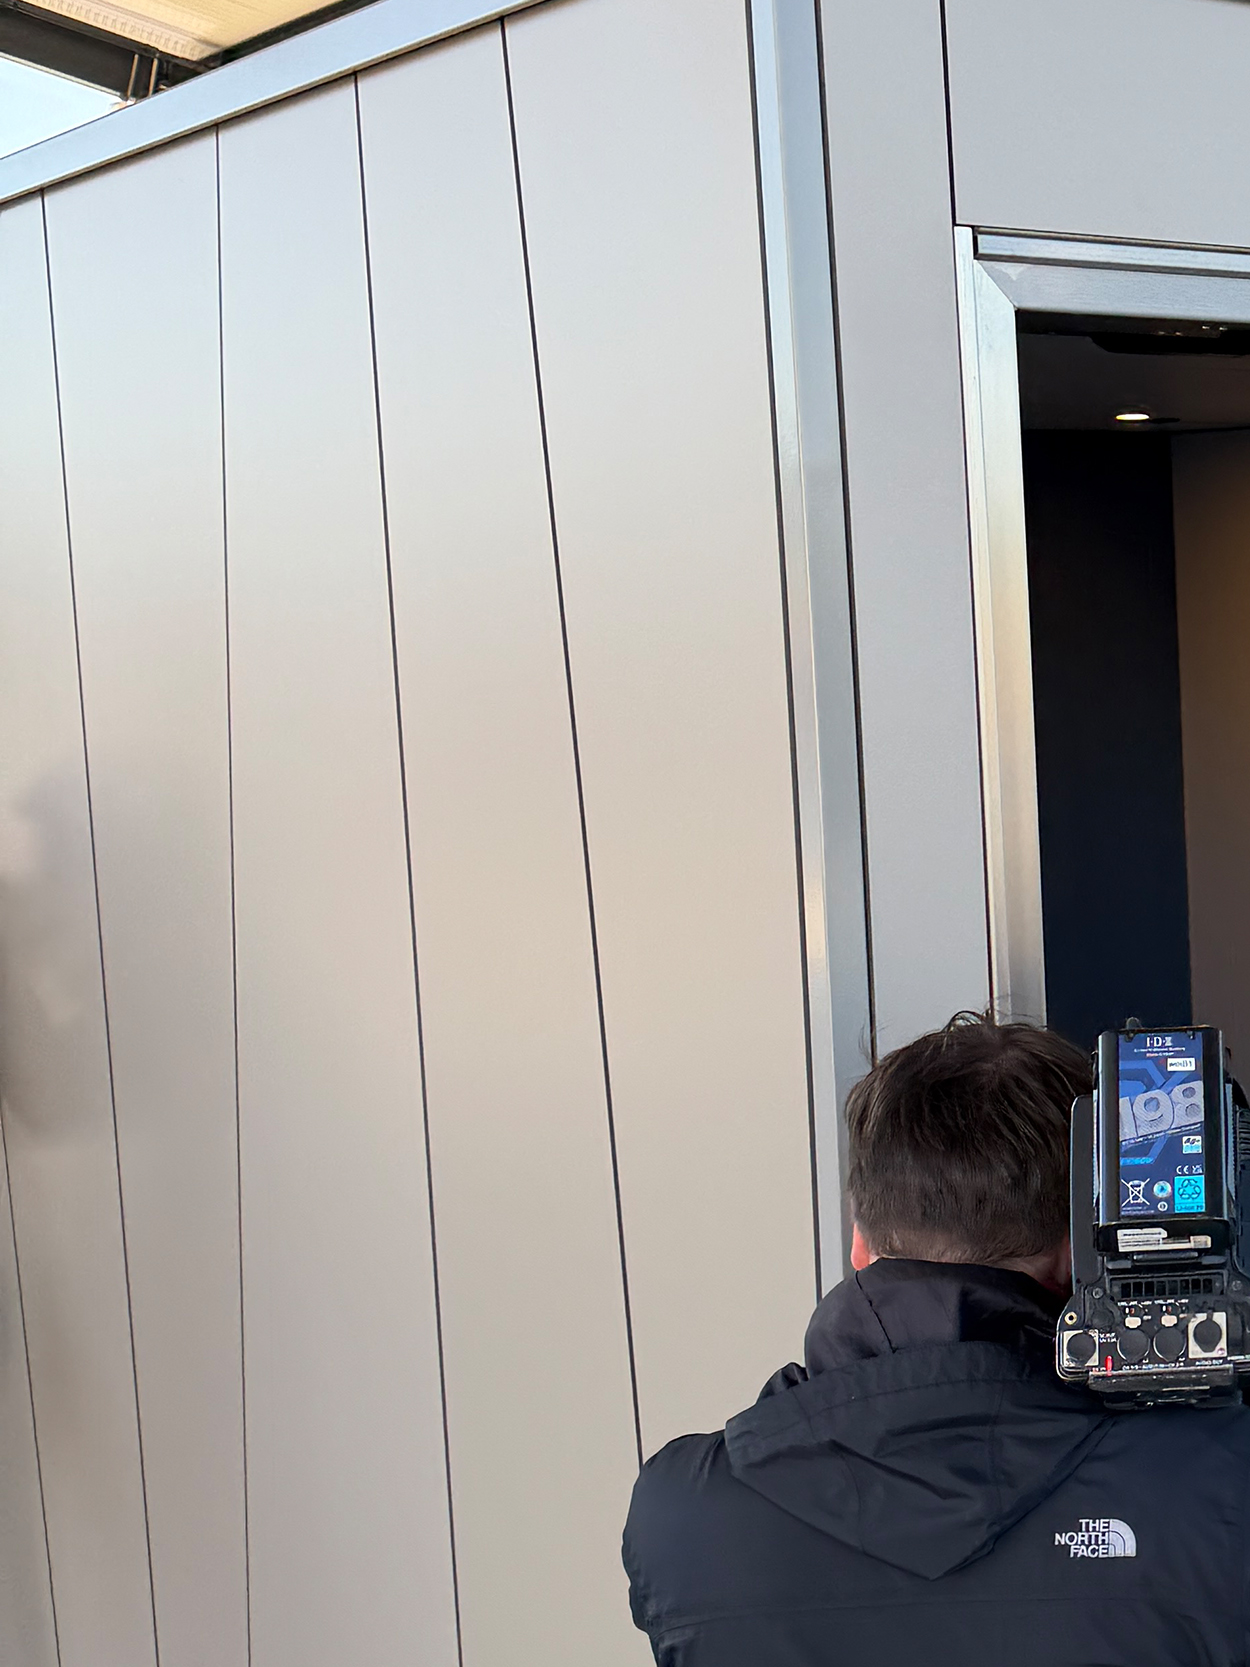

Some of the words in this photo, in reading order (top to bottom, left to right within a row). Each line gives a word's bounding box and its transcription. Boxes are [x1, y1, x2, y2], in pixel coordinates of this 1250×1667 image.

[1079, 1519, 1109, 1532] THE
[1055, 1532, 1109, 1545] NORTH
[1070, 1545, 1109, 1557] FACE
